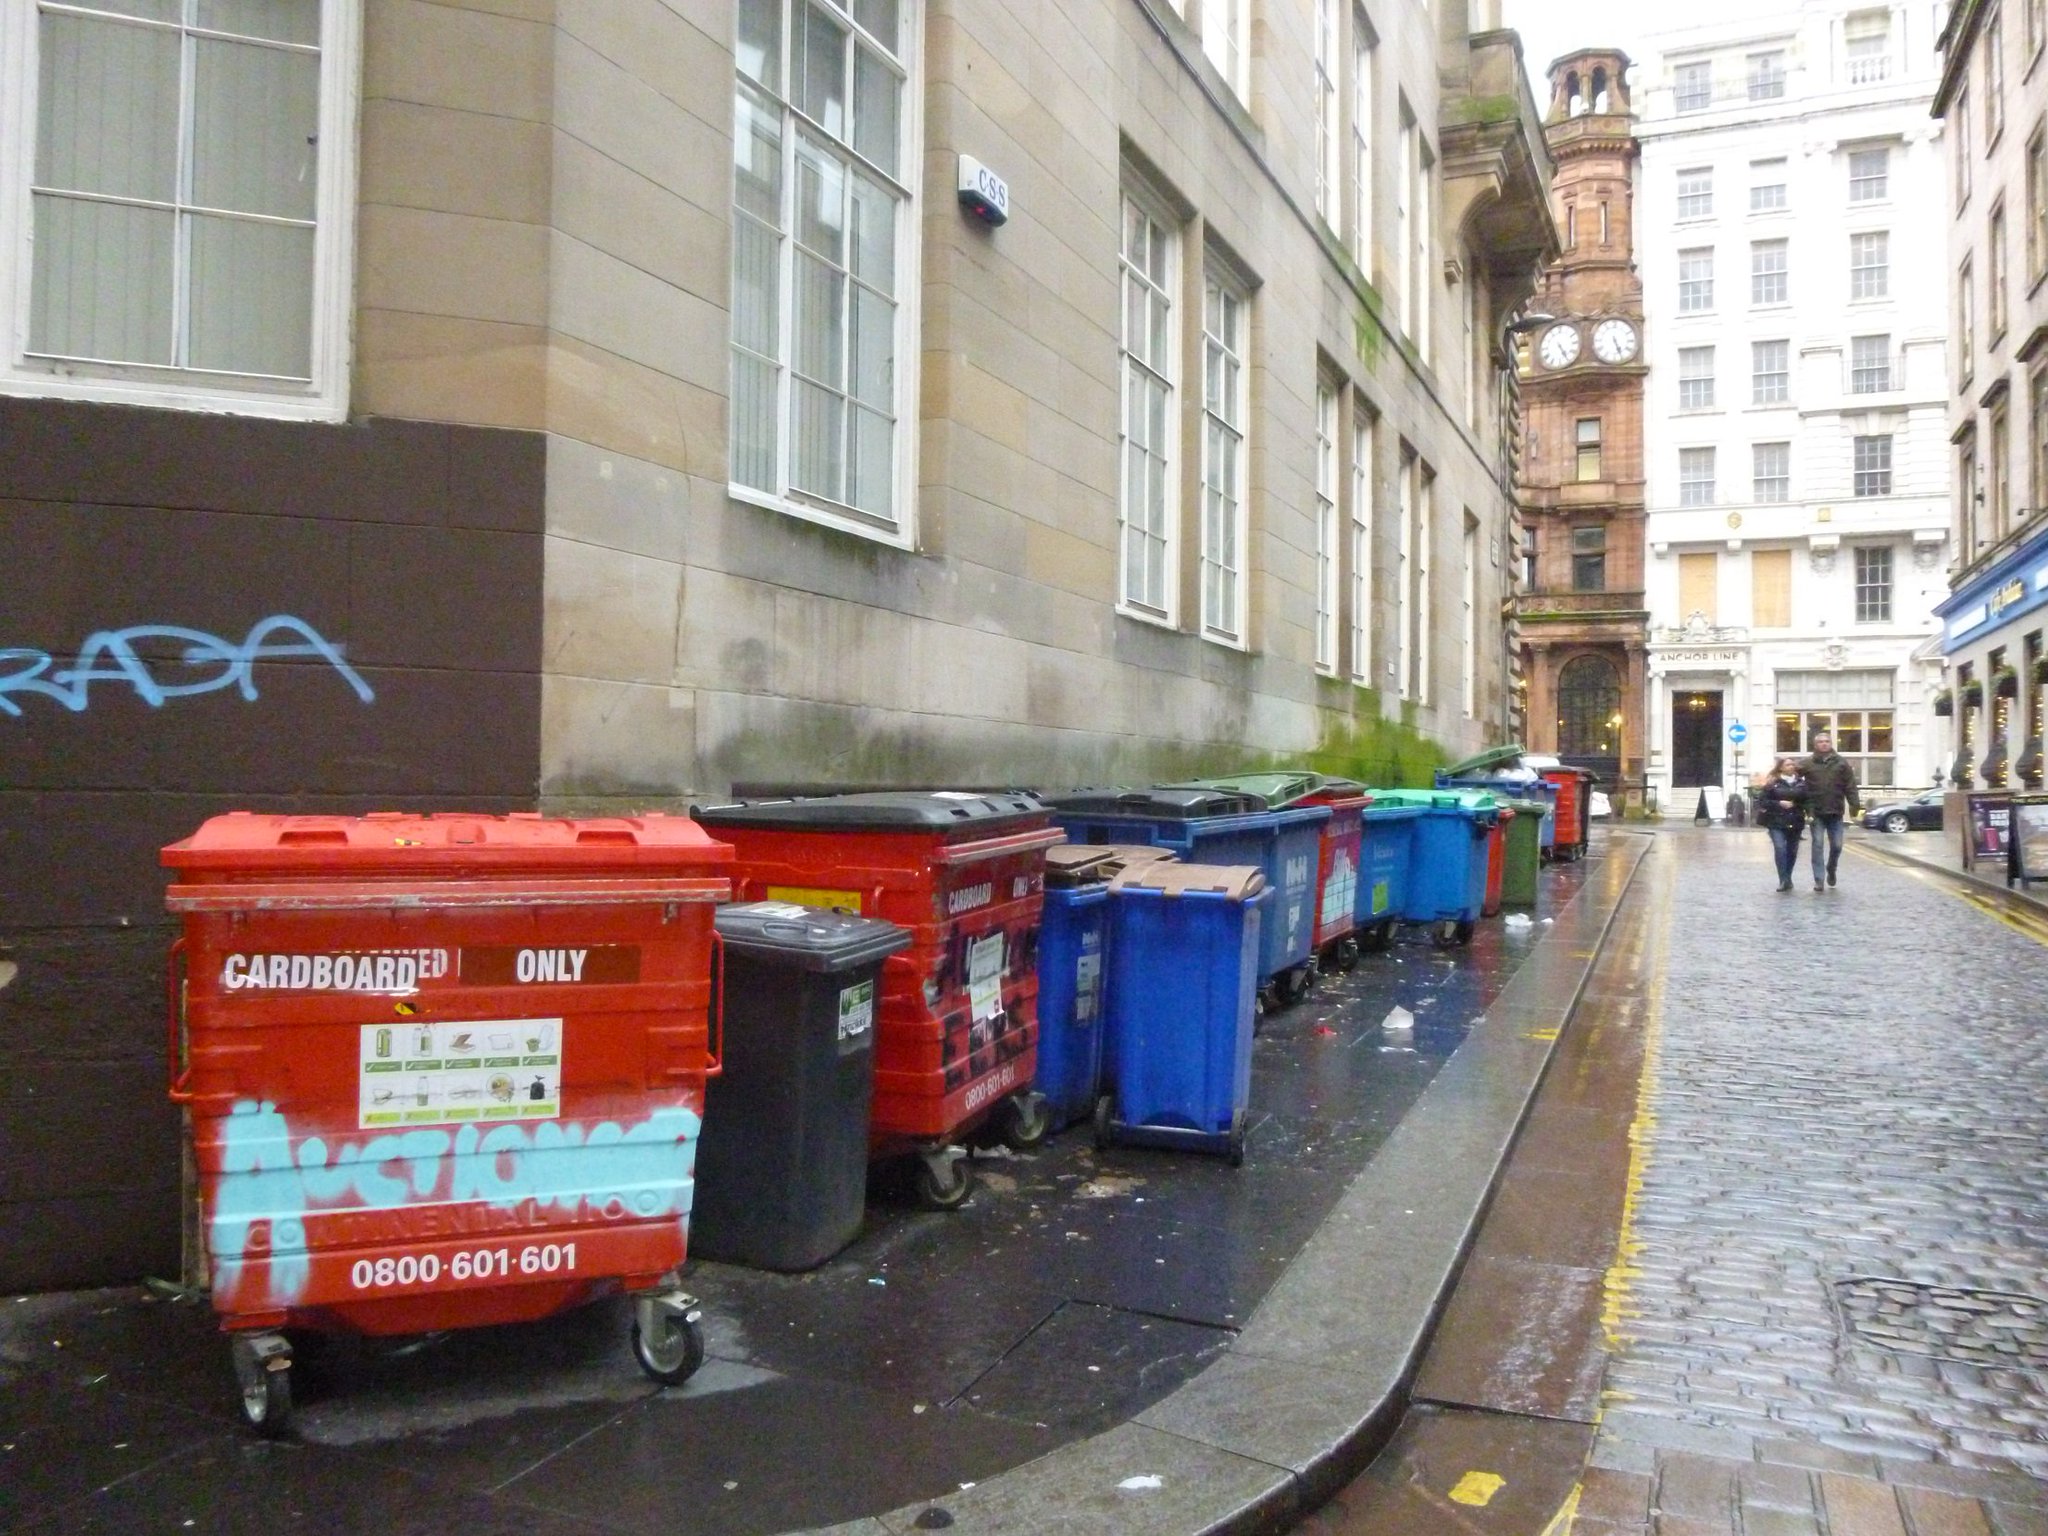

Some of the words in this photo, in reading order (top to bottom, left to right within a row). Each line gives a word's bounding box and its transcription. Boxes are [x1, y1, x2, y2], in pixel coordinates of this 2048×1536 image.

[1660, 652, 1708, 662] ANCHOR
[1714, 651, 1739, 662] LINE
[948, 882, 992, 915] CARDBOARD
[225, 953, 417, 989] CARDBOARD
[517, 949, 587, 982] ONLY
